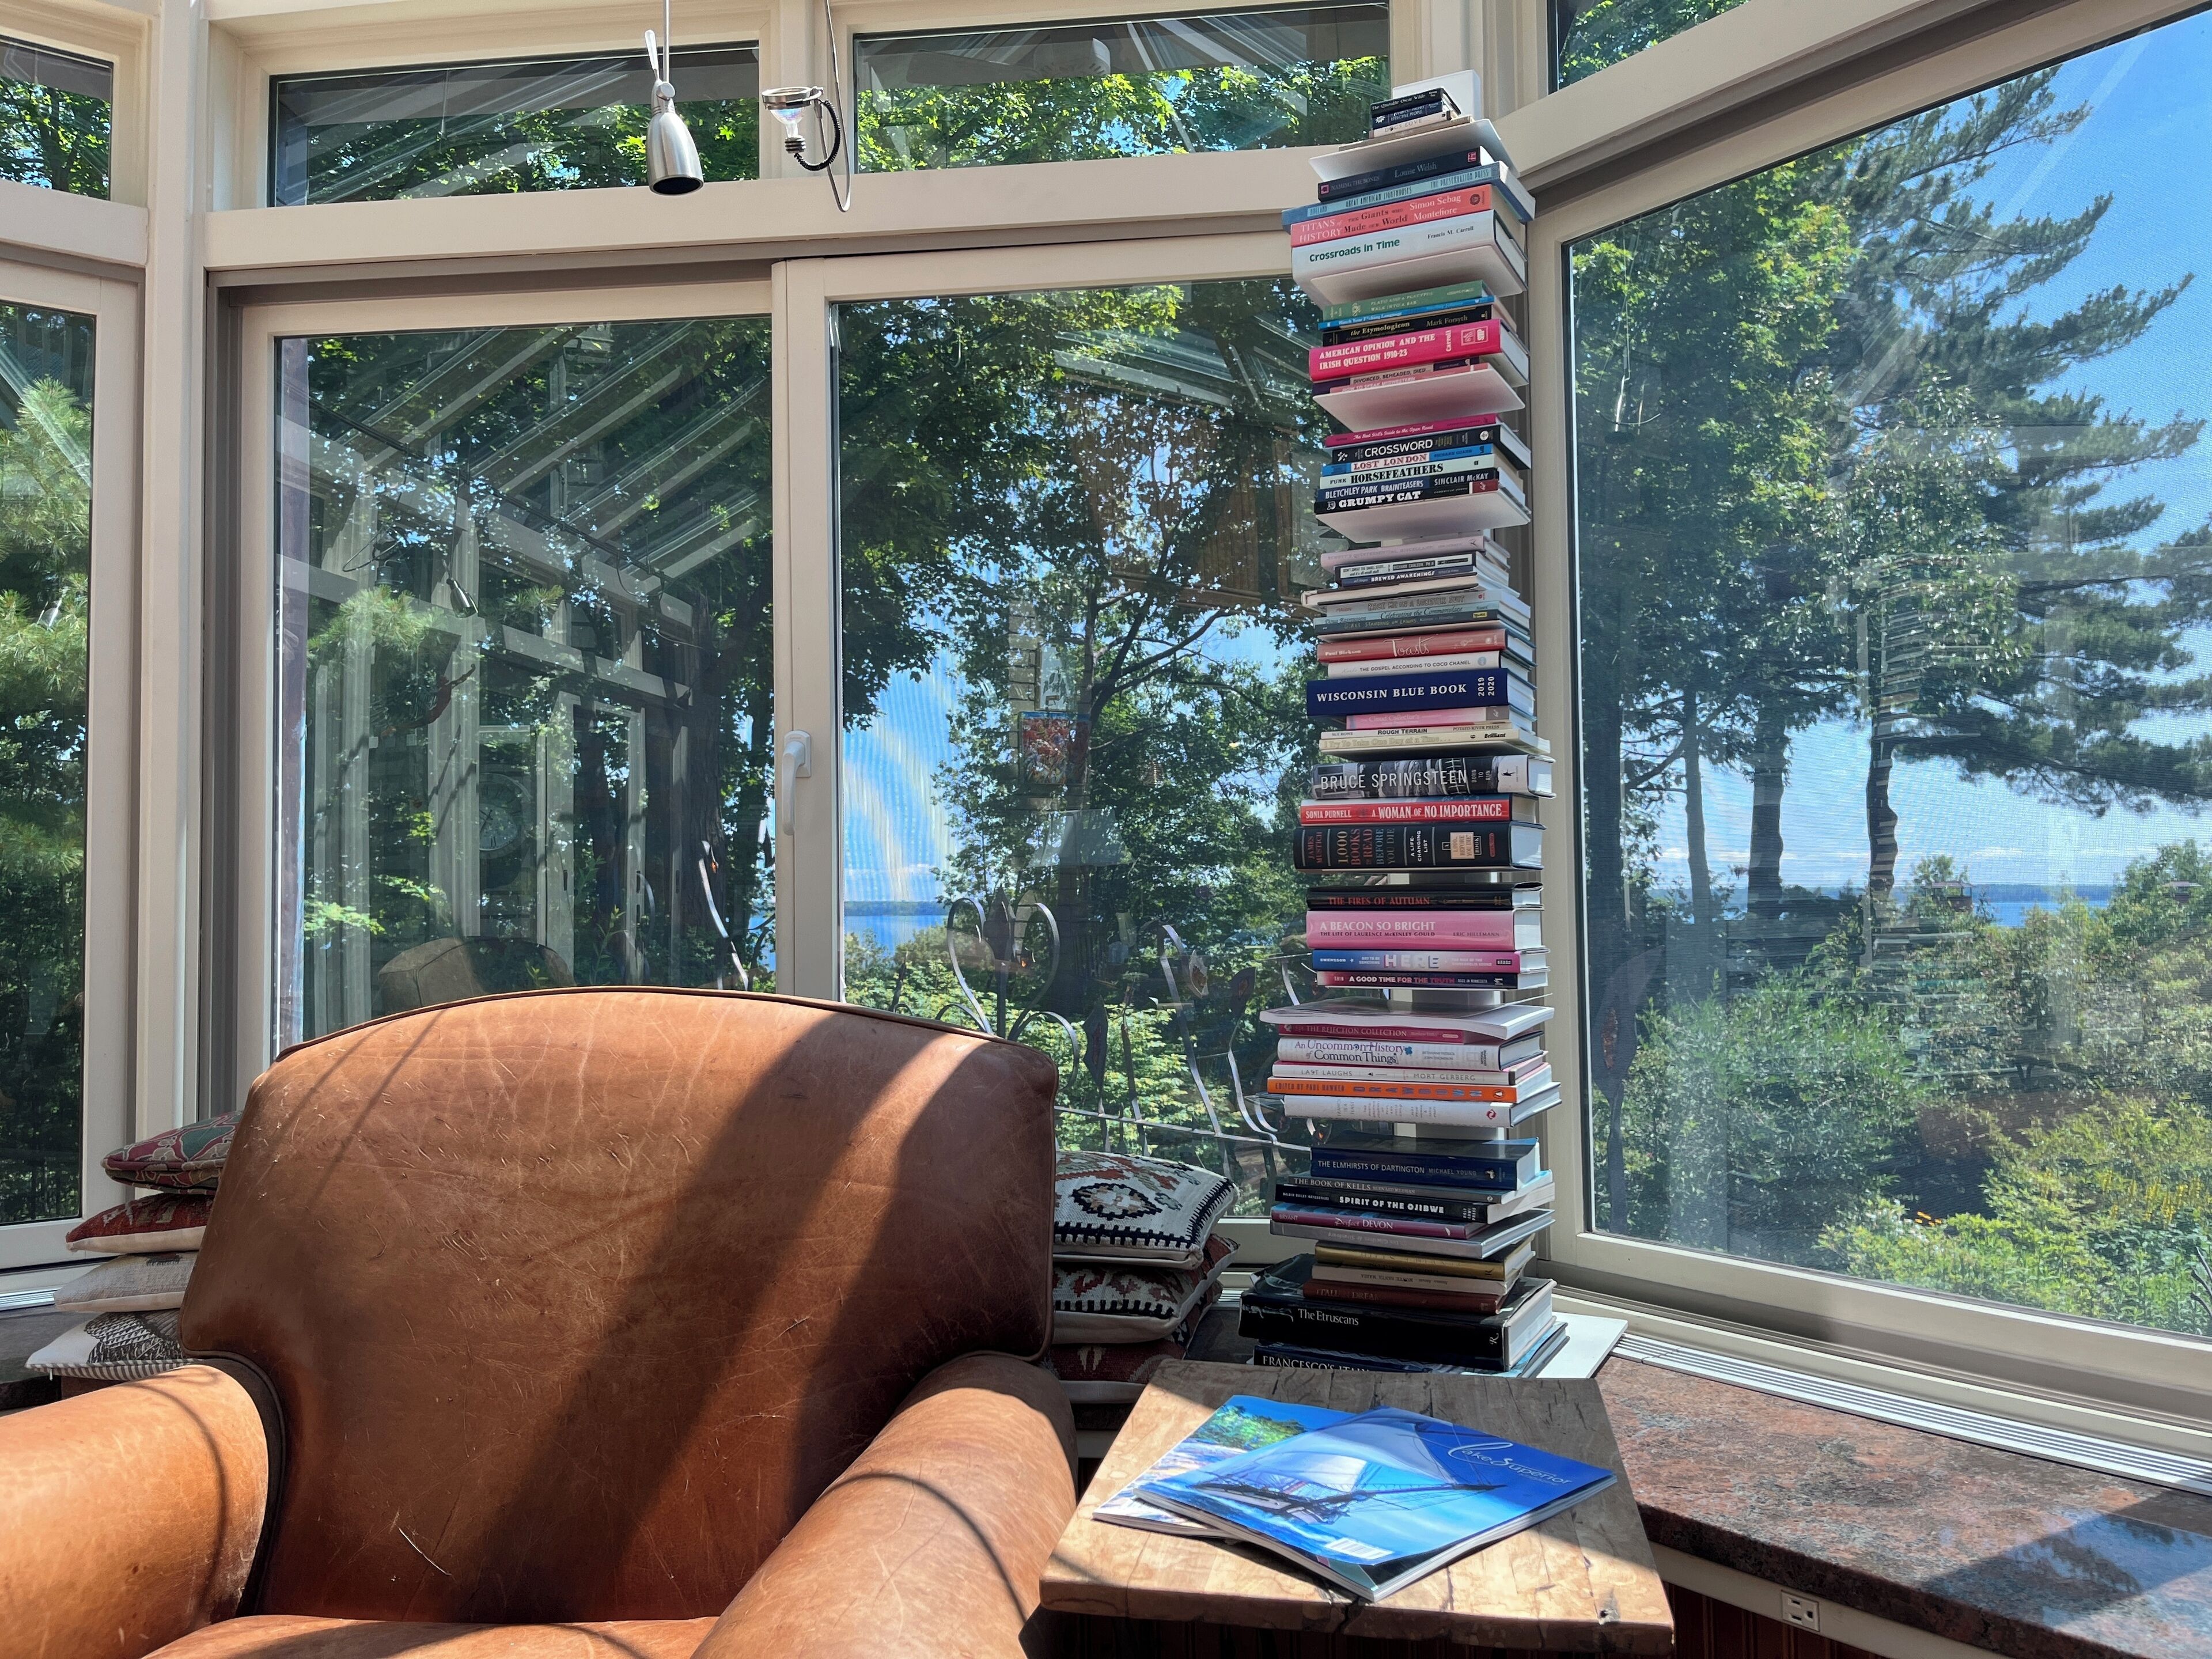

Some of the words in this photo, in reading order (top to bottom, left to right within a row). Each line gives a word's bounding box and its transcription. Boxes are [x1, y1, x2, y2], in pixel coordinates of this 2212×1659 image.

[1405, 119, 1422, 127] LOVE
[1395, 168, 1416, 178] Louise
[1417, 161, 1437, 172] Welsh
[1331, 181, 1352, 191] NAMING
[1440, 172, 1473, 187] PRESERVATION
[1345, 198, 1358, 208] GREAT
[1361, 193, 1381, 206] AMERICAN
[1410, 200, 1435, 211] Simon
[1437, 195, 1461, 206] Sebag
[1361, 210, 1389, 220] Giants
[1413, 207, 1458, 221] Montefiore
[1299, 228, 1343, 244] HISTORY
[1344, 222, 1366, 233] Made
[1382, 214, 1408, 226] World
[1301, 219, 1336, 232] TITANS
[1456, 225, 1474, 233] Carroll
[1309, 246, 1361, 262] Crossroads
[1364, 244, 1373, 252] in
[1376, 239, 1400, 250] Time
[1362, 323, 1410, 334] Etymologicon
[1426, 318, 1442, 327] Mark
[1444, 315, 1468, 324] Forsyth
[1319, 346, 1361, 359] AMERICAN
[1363, 340, 1395, 352] OPINION
[1399, 336, 1416, 346] AND
[1418, 334, 1436, 343] THE
[1319, 360, 1342, 370] IRISH
[1343, 353, 1381, 368] QUESTION
[1384, 349, 1408, 360] 1910-23
[1353, 376, 1381, 384] DIVORCED,
[1382, 370, 1411, 380] BEHEADED,
[1365, 439, 1433, 457] CROSSWORD
[1354, 460, 1380, 471] LOST
[1384, 453, 1427, 467] LONDON
[1350, 463, 1444, 484] HORSEFEATHERS
[1434, 475, 1465, 486] SINCLAIR
[1467, 472, 1489, 482] McKAY
[1325, 486, 1360, 500] BLETCHLEY
[1361, 485, 1378, 495] PARK
[1381, 479, 1424, 493] BRAINTEASERS
[1338, 493, 1395, 509] GRUMPY
[1396, 490, 1422, 502] CAT
[1396, 571, 1435, 579] AWAKENINGS
[1423, 605, 1464, 615] Commonplace
[1382, 636, 1434, 657] Toasts
[1316, 689, 1388, 702] WISCONSIN
[1392, 687, 1425, 698] BLUE
[1430, 684, 1467, 695] BOOK
[1389, 737, 1403, 746] Day
[1320, 774, 1366, 790] BRUCE
[1372, 770, 1467, 788] SPRINGSTEEN
[1305, 810, 1324, 819] SONIA
[1325, 809, 1352, 819] PURNELL
[1378, 806, 1412, 819] WOMAN
[1414, 808, 1422, 816] OF
[1424, 805, 1437, 818] NO
[1440, 803, 1502, 818] IMPORTANCE
[1362, 829, 1373, 858] READ
[1387, 828, 1395, 844] DIE
[1336, 831, 1349, 863] 1,000
[1350, 828, 1361, 865] BOOKS
[1375, 828, 1384, 865] BEFORE
[1387, 846, 1395, 864] YOU
[1328, 897, 1344, 905] THE
[1348, 897, 1371, 905] FIRES
[1373, 897, 1386, 905] OF
[1389, 897, 1430, 905] AUTUMN
[1320, 922, 1327, 931] A
[1330, 921, 1373, 931] BEACON
[1376, 921, 1391, 931] SO
[1395, 921, 1436, 931] BRIGHT
[1383, 954, 1439, 969] HERE
[1295, 1041, 1305, 1049] An
[1307, 1040, 1369, 1051] Uncommon
[1368, 1041, 1405, 1055] History
[1305, 1051, 1313, 1059] of
[1314, 1050, 1362, 1062] Common
[1362, 1051, 1397, 1065] Things
[1275, 1082, 1295, 1090] EDITED
[1306, 1084, 1320, 1092] PAUL
[1317, 1160, 1331, 1168] THE
[1332, 1161, 1369, 1171] ELMHIRSTS
[1370, 1163, 1380, 1171] OF
[1381, 1165, 1425, 1174] DARTINGTON
[1310, 1179, 1332, 1188] BOOK
[1334, 1181, 1344, 1189] OF
[1346, 1183, 1372, 1191] KELLS
[1339, 1195, 1370, 1206] SPIRIT
[1372, 1199, 1384, 1207] OF
[1387, 1200, 1404, 1210] THE
[1407, 1203, 1445, 1214] OJIBWE
[1334, 1217, 1360, 1227] Perfect
[1362, 1218, 1393, 1229] DEVON
[1298, 1308, 1315, 1320] The
[1316, 1310, 1359, 1326] Etruscans
[1490, 1457, 1573, 1485] Superior
